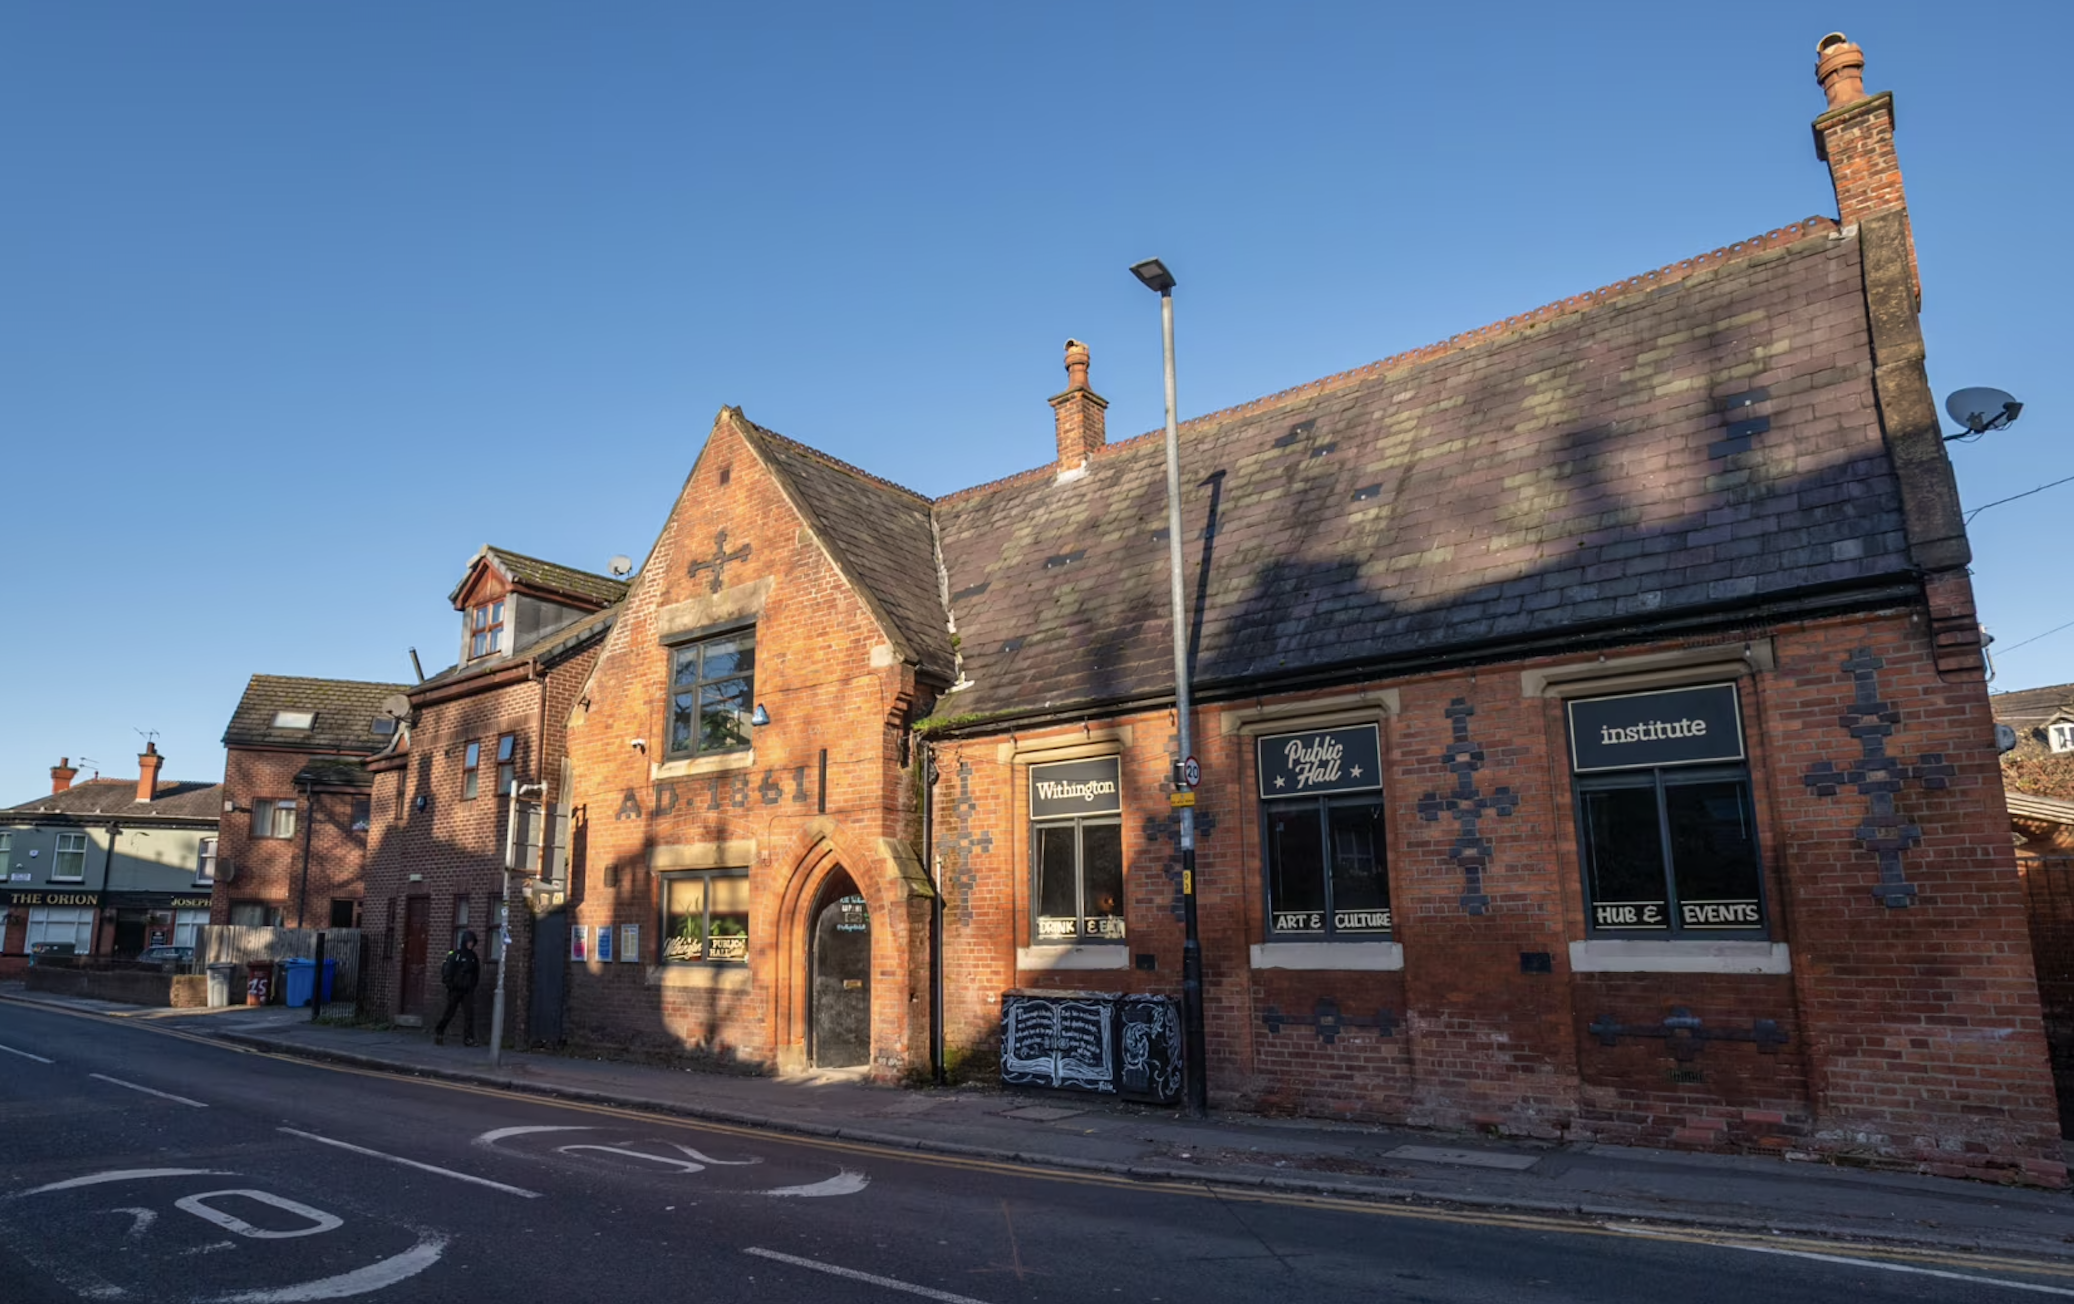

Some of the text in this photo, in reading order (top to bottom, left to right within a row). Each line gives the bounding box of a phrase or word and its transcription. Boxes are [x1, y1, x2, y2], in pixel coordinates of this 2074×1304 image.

[1601, 718, 1707, 745] institute
[1284, 736, 1344, 769] Public
[1187, 765, 1199, 779] 20
[1295, 760, 1342, 789] Hall
[707, 767, 807, 811] 1861
[1036, 780, 1116, 801] Withington
[11, 893, 98, 905] THE ORION
[1277, 913, 1391, 930] ART & CULTURE
[1597, 904, 1759, 923] HUB & EVENTS
[1039, 921, 1075, 934] DRINK
[1087, 920, 1098, 934] &
